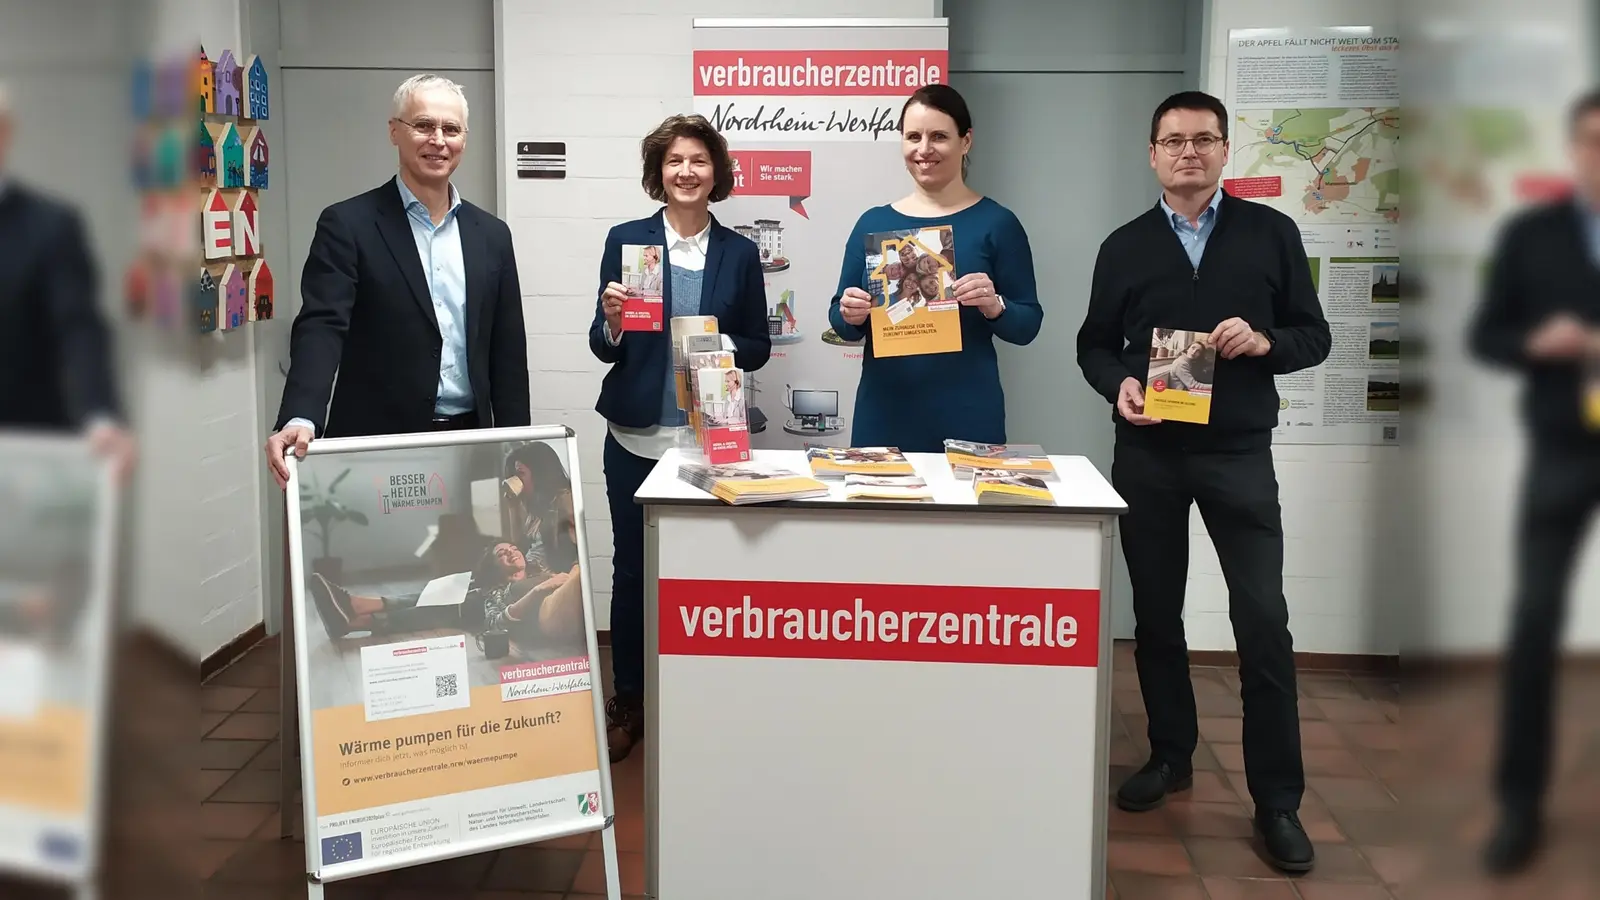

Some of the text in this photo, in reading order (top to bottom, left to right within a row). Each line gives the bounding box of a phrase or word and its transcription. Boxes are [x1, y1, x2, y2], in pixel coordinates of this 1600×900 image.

[1257, 39, 1283, 47] APFEL
[1285, 38, 1307, 46] FÄLLT
[1310, 38, 1336, 46] NICHT
[1338, 37, 1359, 45] WEIT
[1361, 37, 1382, 45] VOM
[1383, 36, 1399, 45] STA
[700, 58, 940, 87] verbraucherzentrale
[523, 144, 529, 152] 4
[760, 165, 803, 173] Wir machen
[760, 173, 794, 181] Sie stark.
[390, 473, 425, 486] BESSER
[390, 486, 427, 499] HEIZEN
[678, 595, 1078, 648] verbraucherzentrale
[502, 658, 590, 680] verbraucherzentrale
[339, 710, 562, 756] Wärme pumpen für die Zukunft?
[375, 754, 391, 763] dich
[429, 743, 458, 754] möglich
[353, 751, 518, 784] www.verbraucherzentrale.nrw/waermepumpe
[370, 817, 440, 835] EUROPÄISCHE UNION
[480, 822, 498, 830] Landes
[414, 833, 434, 841] Fonds
